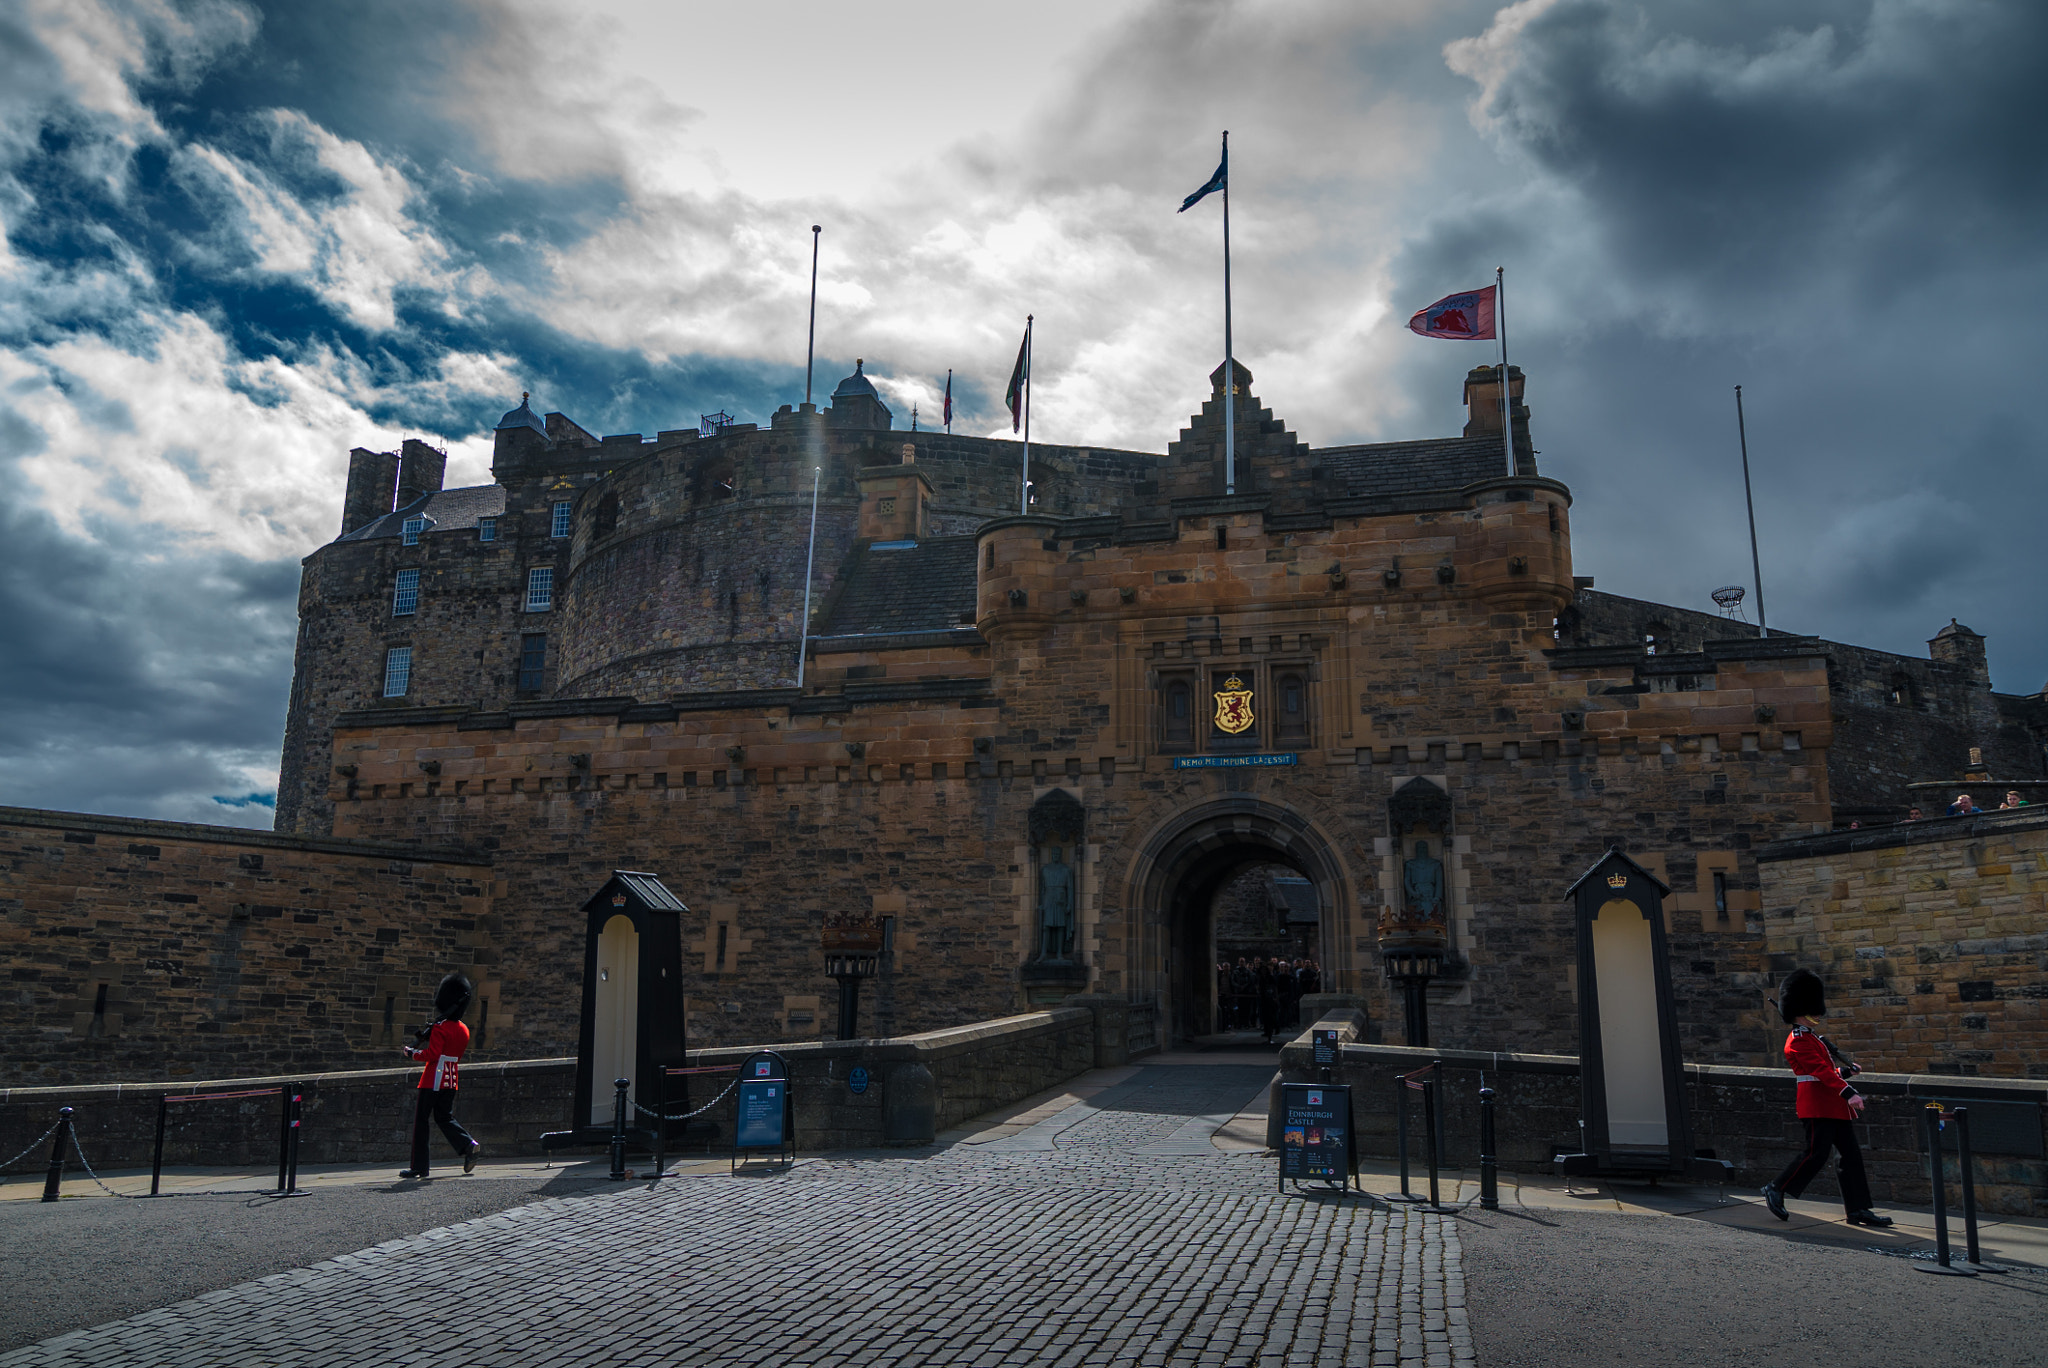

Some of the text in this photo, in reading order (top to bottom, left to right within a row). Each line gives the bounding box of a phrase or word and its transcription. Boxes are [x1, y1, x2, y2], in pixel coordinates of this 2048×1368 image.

[1181, 759, 1203, 767] NEMO
[1205, 757, 1216, 766] ME
[1220, 757, 1250, 766] IMPUNE
[1289, 1110, 1333, 1118] EDINBURGH
[1288, 1118, 1314, 1126] CASTLE
